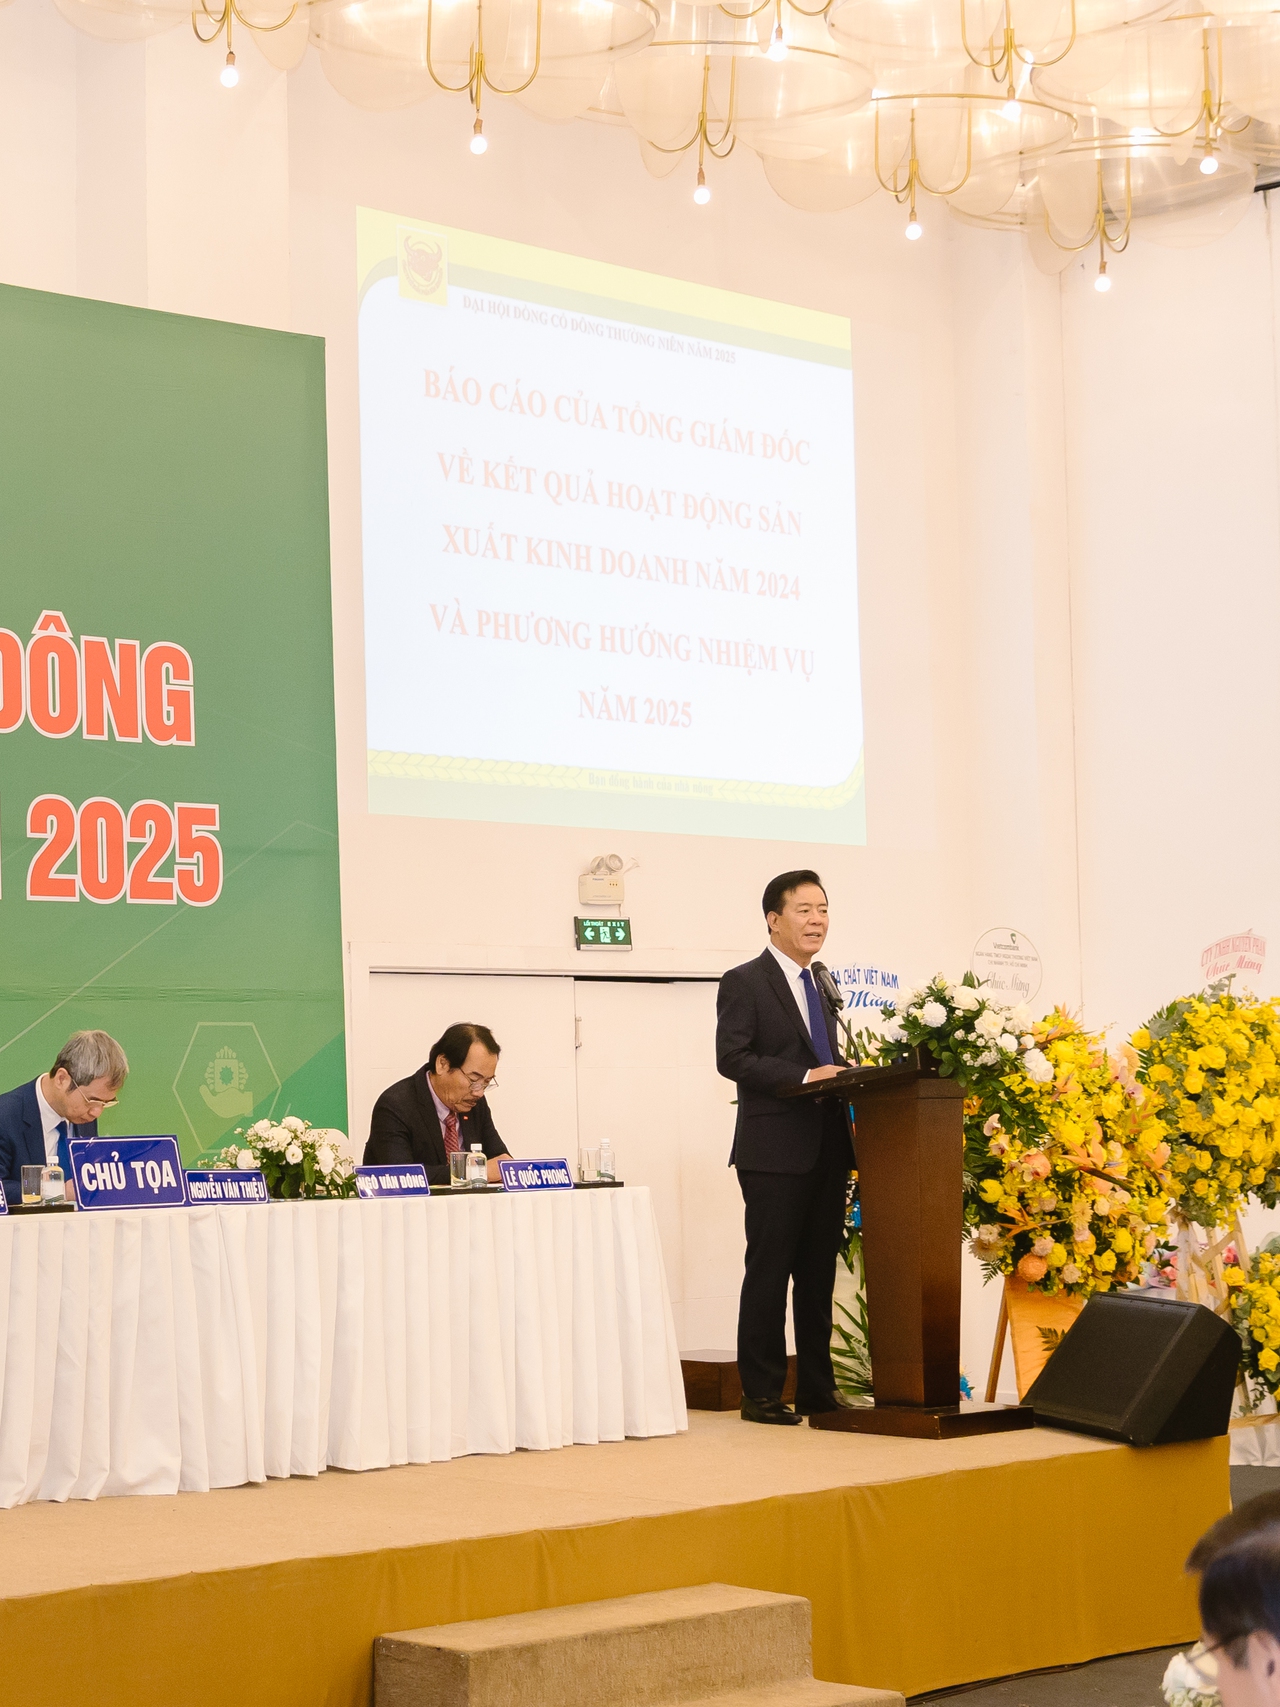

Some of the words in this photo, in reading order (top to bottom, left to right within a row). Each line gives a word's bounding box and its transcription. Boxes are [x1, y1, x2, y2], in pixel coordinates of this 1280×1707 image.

[714, 348, 736, 364] 2025
[423, 365, 482, 407] BÁO
[489, 378, 545, 418] CÁO
[553, 389, 609, 430] CỦA
[612, 399, 684, 444] TỔNG
[690, 418, 755, 457] GIÁM
[760, 428, 812, 467] ĐỐC
[436, 447, 476, 485] VỀ
[482, 455, 537, 495] KẾT
[543, 468, 600, 506] QUẢ
[606, 480, 677, 522] HOẠT
[682, 492, 752, 531] ĐỘNG
[758, 500, 803, 538] SẢN
[441, 521, 518, 563] XUẤT
[525, 535, 593, 574] KINH
[599, 546, 690, 588] DOANH
[695, 557, 750, 596] NĂM
[756, 570, 801, 602] 2024
[428, 597, 470, 637] VÀ
[476, 609, 592, 651] PHƯƠNG
[599, 622, 692, 664] HƯỚNG
[698, 636, 779, 678] NHIỆM
[784, 647, 815, 684] VỤ
[578, 685, 637, 725] NĂM
[643, 698, 693, 729] 2025
[26, 794, 223, 907] 2025
[843, 963, 861, 985] CHẤT
[863, 966, 878, 988] VIỆT
[881, 971, 899, 989] NAM
[81, 1151, 126, 1192] CHỦ
[131, 1160, 177, 1194] TỌA
[189, 1174, 222, 1199] NGUYỄN
[222, 1178, 240, 1199] VĂN
[241, 1177, 265, 1201] THIỆU
[357, 1173, 380, 1191] NGÔ
[380, 1171, 403, 1190] VĂN
[504, 1167, 518, 1186] LÊ
[518, 1163, 542, 1186] QUỐC
[542, 1168, 569, 1185] PHONG
